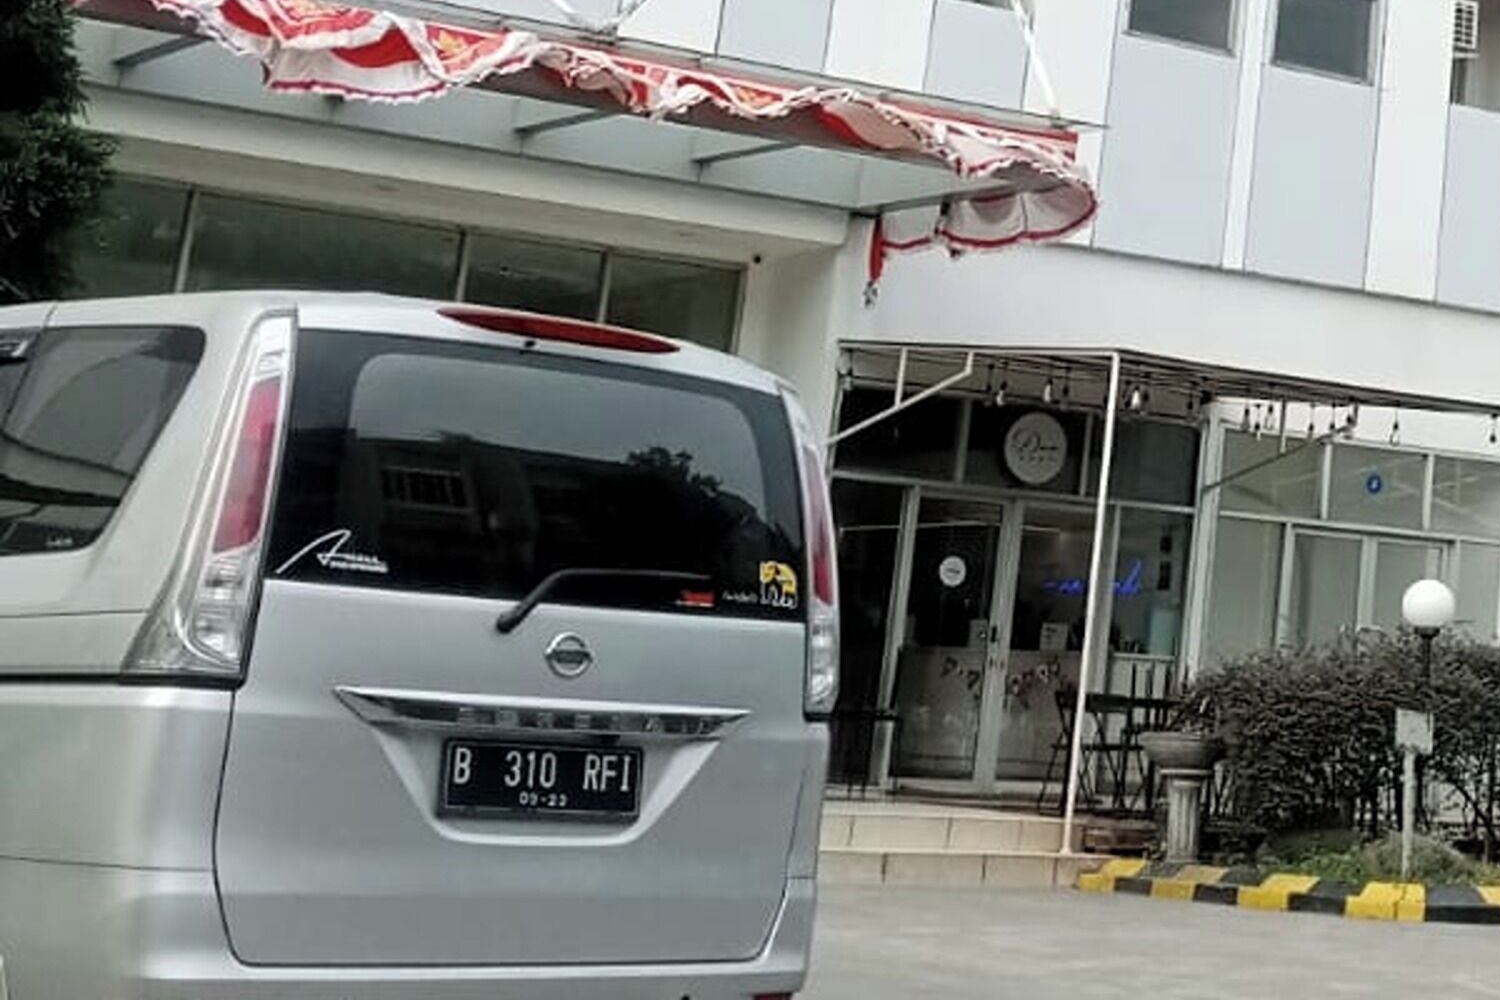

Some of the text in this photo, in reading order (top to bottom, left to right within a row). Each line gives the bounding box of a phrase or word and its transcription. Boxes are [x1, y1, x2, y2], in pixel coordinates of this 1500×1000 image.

[453, 747, 632, 792] B 310 RFI
